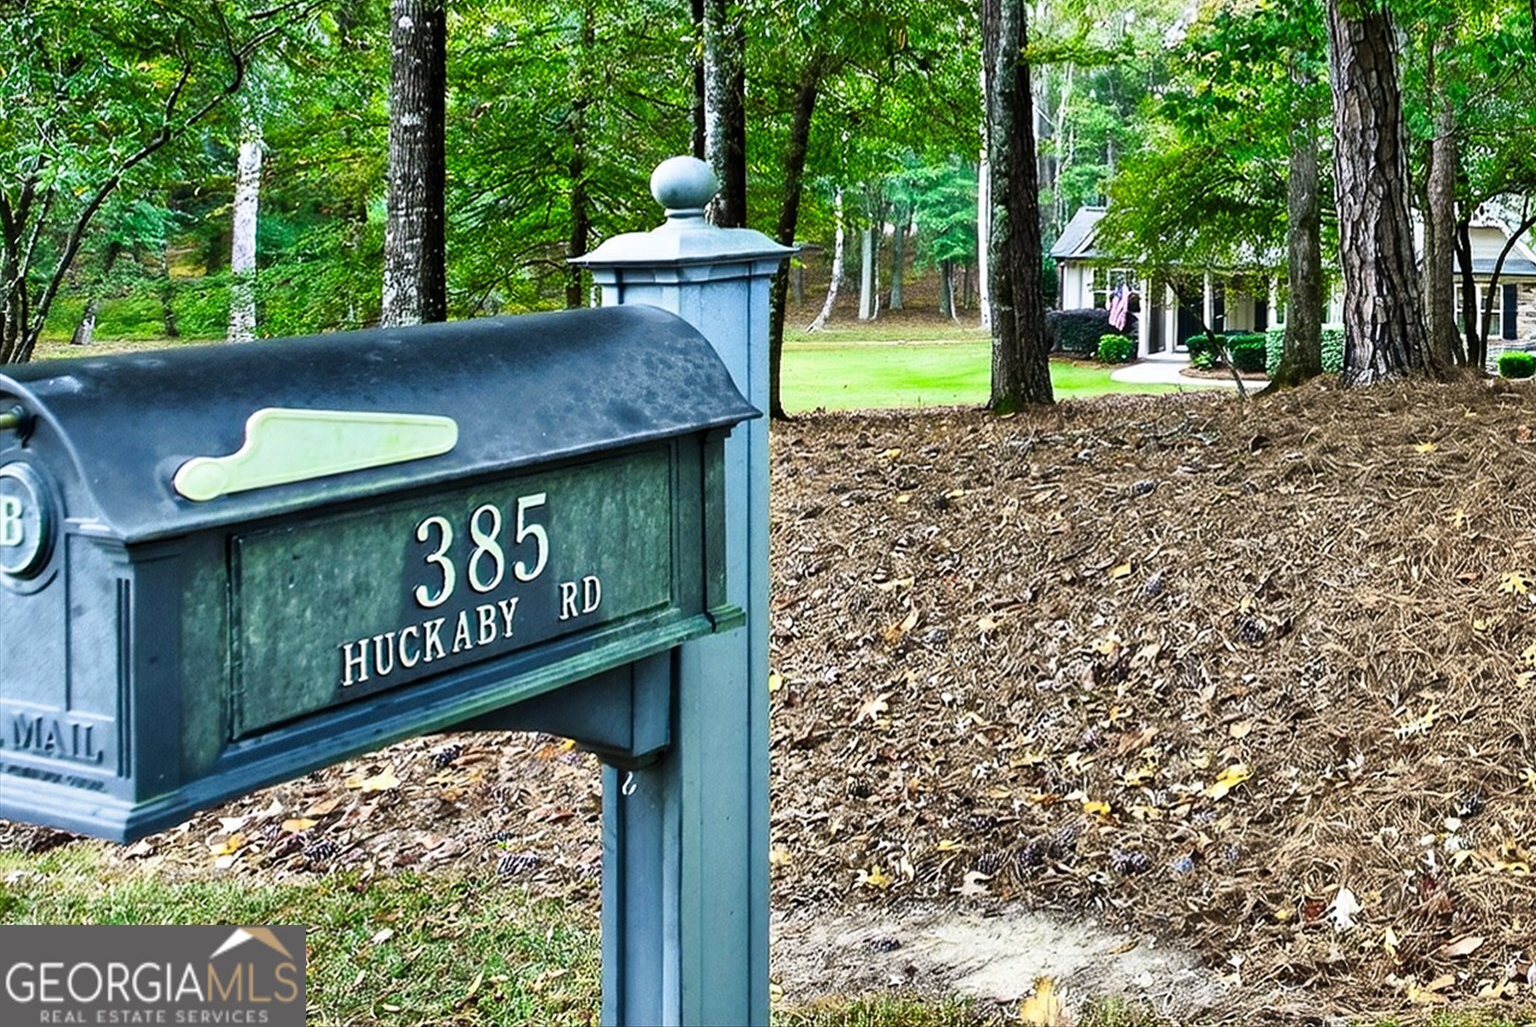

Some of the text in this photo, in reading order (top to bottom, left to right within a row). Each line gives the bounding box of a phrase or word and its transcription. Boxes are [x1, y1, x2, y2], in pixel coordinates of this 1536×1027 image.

[414, 492, 549, 608] 385
[339, 575, 601, 686] HUCKABY RD
[11, 712, 104, 765] MAIL
